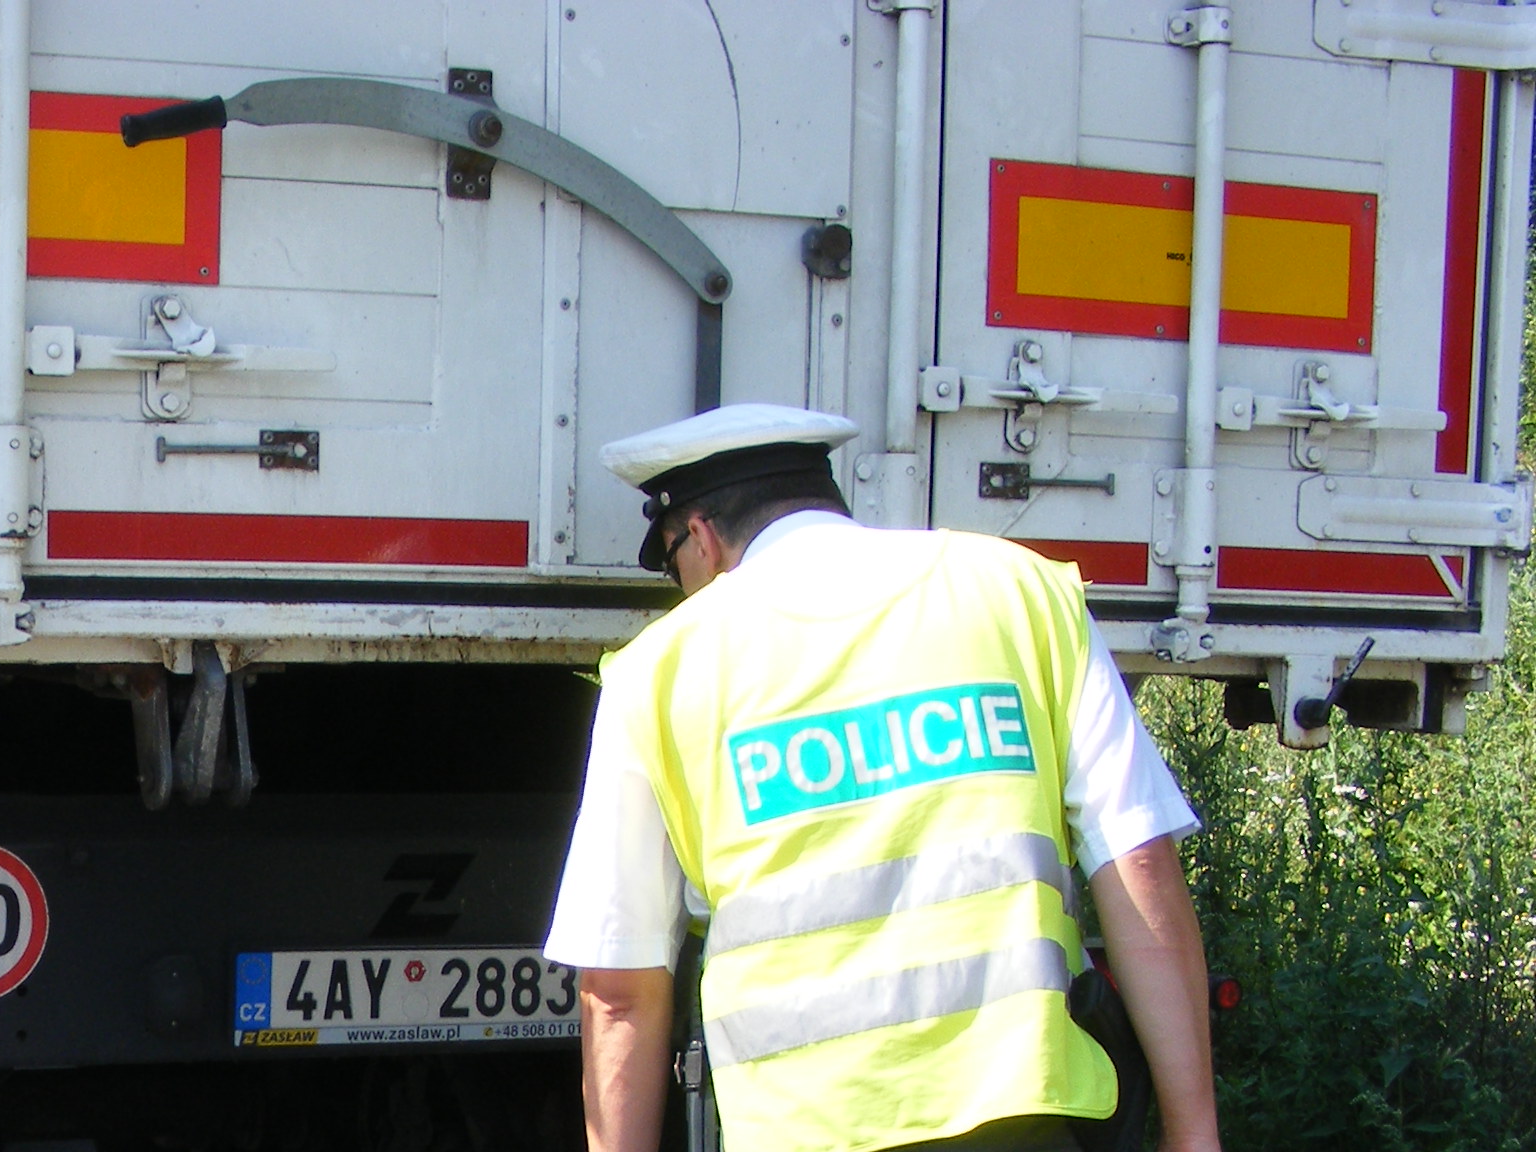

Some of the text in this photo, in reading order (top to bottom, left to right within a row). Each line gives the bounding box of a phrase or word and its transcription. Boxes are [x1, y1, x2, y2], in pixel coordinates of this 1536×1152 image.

[735, 695, 1030, 811] POLICIE
[285, 956, 577, 1021] 4AY 2883
[239, 1002, 266, 1021] CZ
[347, 1023, 461, 1042] www.zaslaw.pl
[522, 1023, 545, 1037] 508
[548, 1023, 563, 1037] 01
